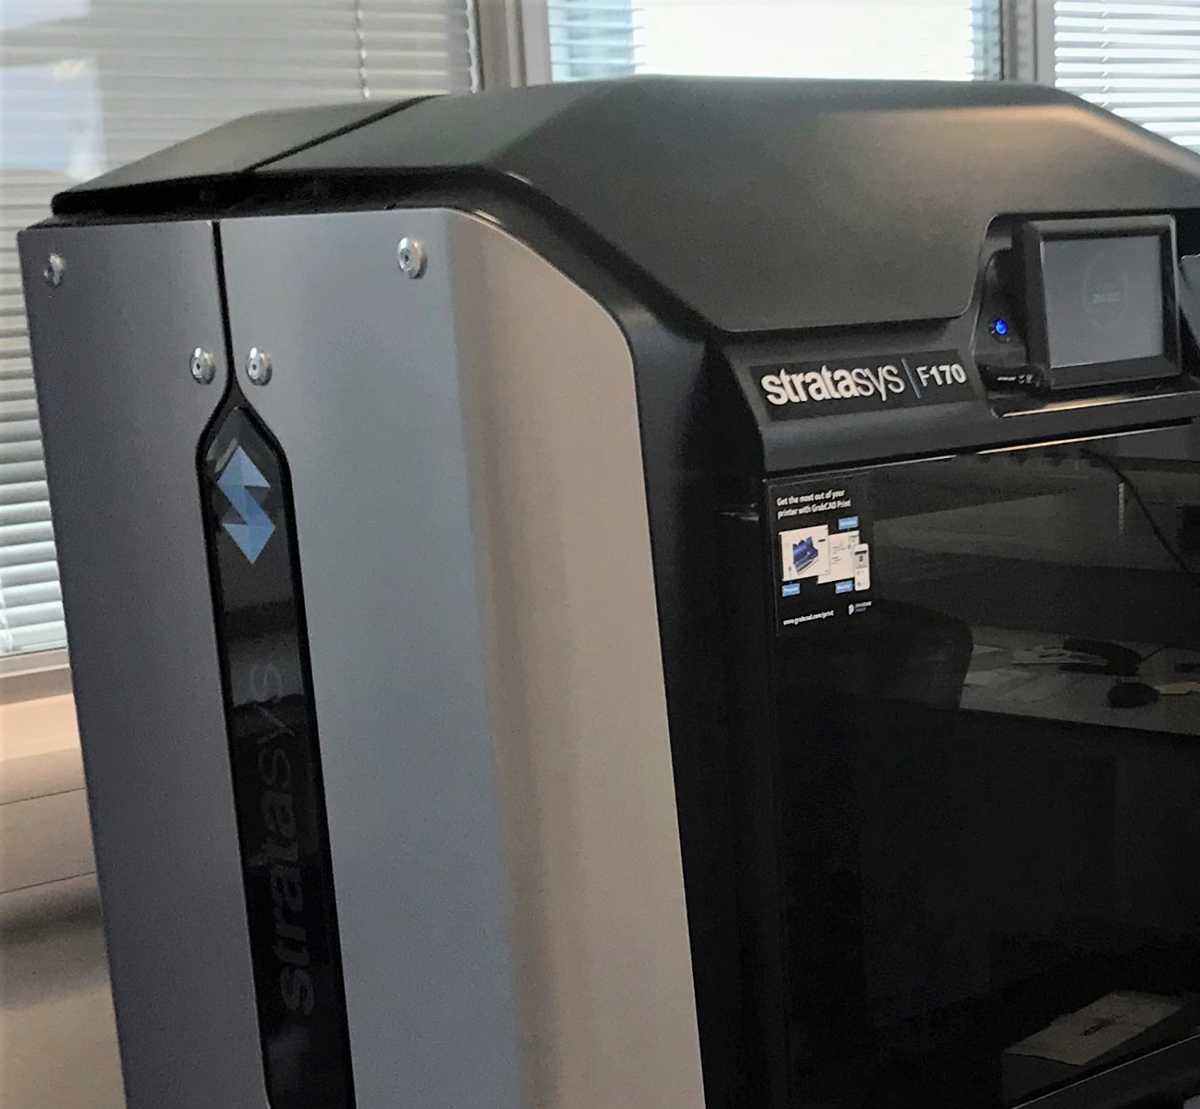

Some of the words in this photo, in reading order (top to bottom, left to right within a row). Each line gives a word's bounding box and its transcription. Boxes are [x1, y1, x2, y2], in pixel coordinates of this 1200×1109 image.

[761, 365, 905, 405] stratasys
[916, 363, 967, 387] F170
[777, 497, 788, 506] Get
[788, 495, 799, 504] the
[799, 493, 814, 503] most
[814, 492, 825, 500] out
[825, 489, 833, 499] of
[832, 490, 845, 500] your
[778, 509, 798, 520] printer
[798, 505, 811, 514] with
[837, 500, 851, 508] Print
